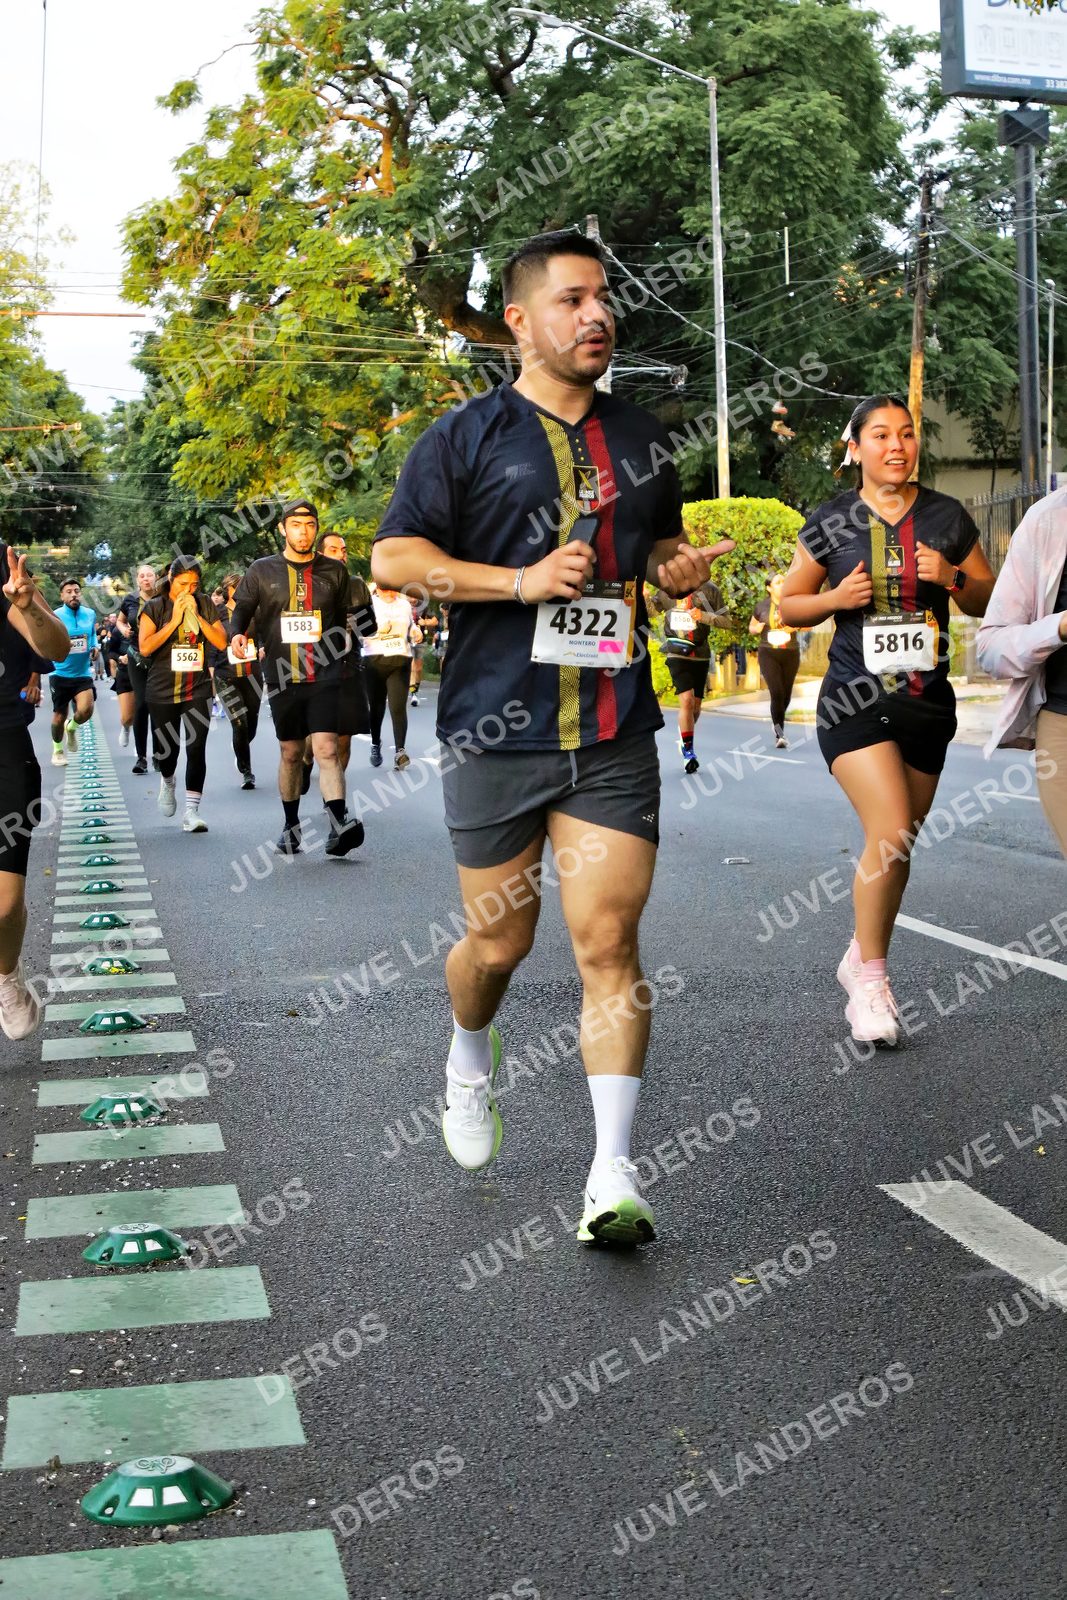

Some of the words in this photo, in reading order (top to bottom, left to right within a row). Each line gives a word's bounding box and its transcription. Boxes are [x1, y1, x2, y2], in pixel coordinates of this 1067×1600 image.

[286, 620, 313, 632] 1583
[550, 606, 618, 637] 4322
[874, 631, 924, 654] 5816
[176, 652, 198, 661] 5562
